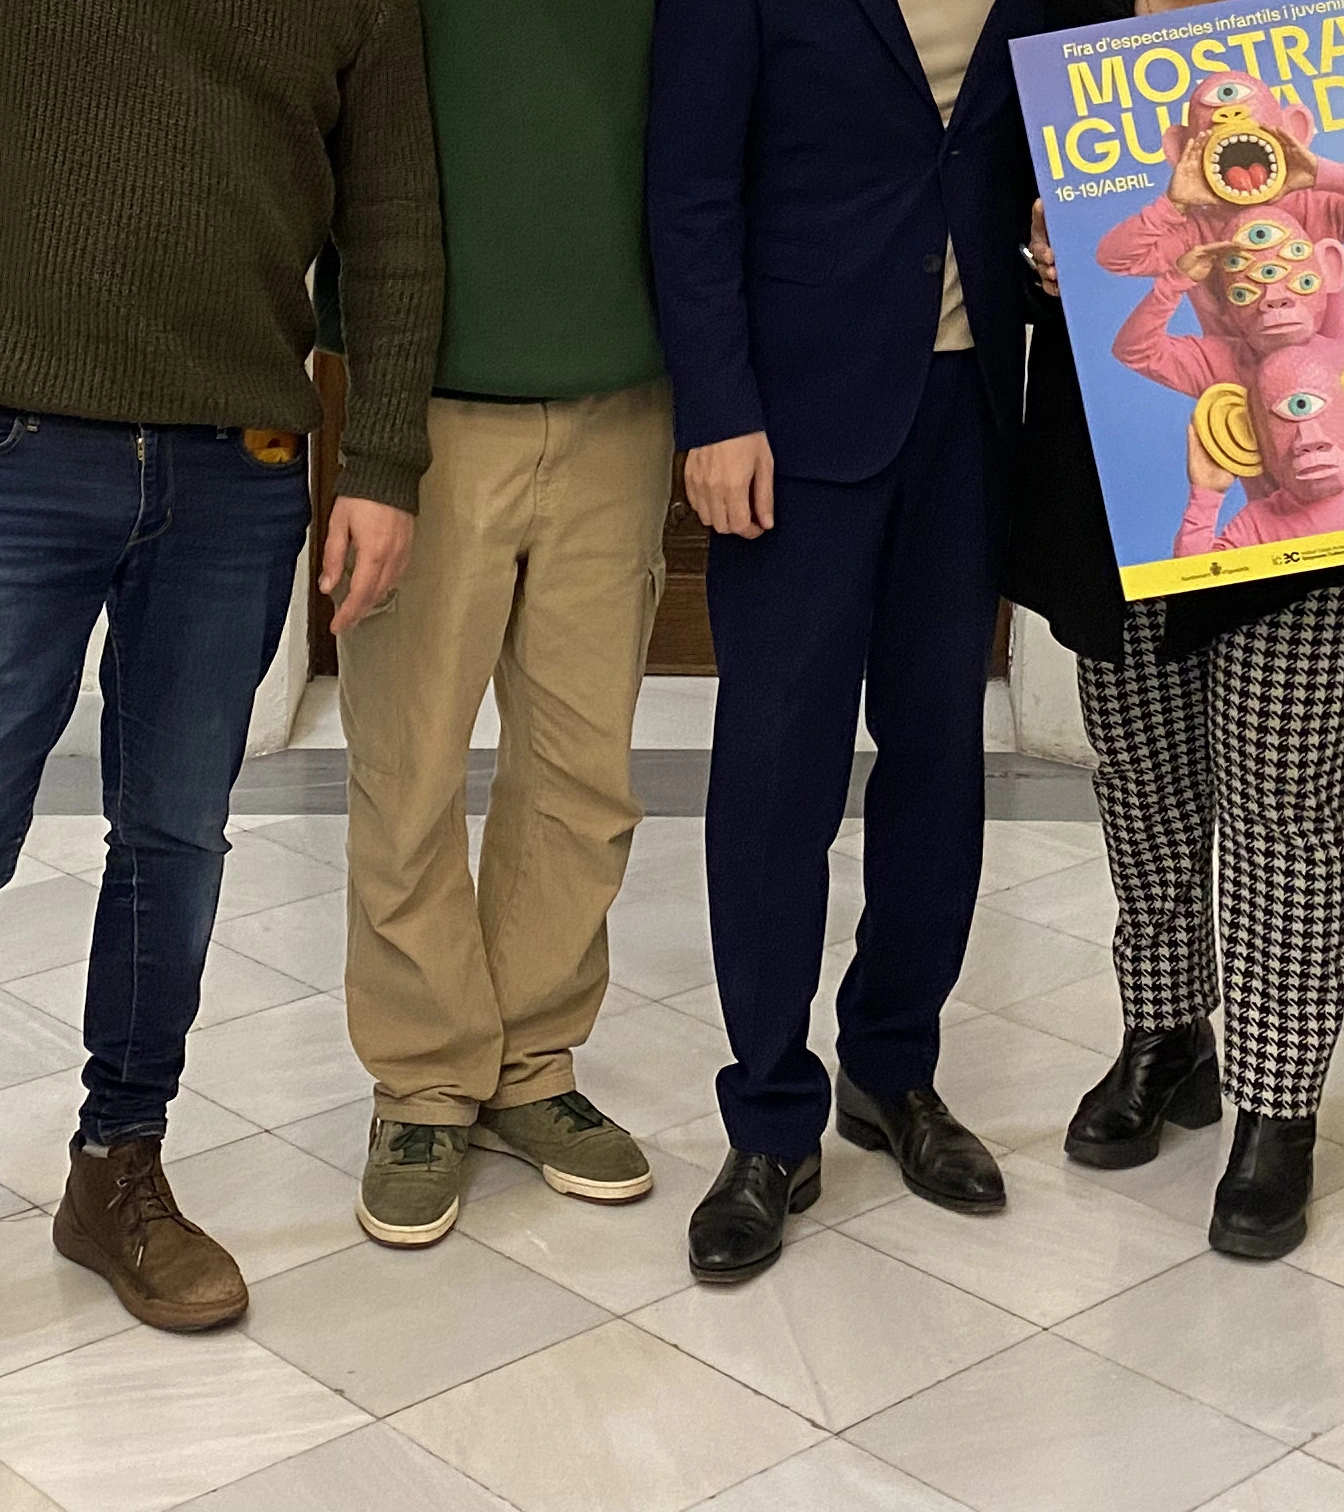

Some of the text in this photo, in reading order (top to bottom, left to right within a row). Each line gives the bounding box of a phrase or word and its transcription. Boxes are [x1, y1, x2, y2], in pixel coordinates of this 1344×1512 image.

[1062, 41, 1093, 59] Fira
[1095, 22, 1213, 52] d'espectacles
[1215, 7, 1281, 31] infantils
[1282, 5, 1289, 20] i
[1055, 173, 1155, 202] 16-19/ABRIL
